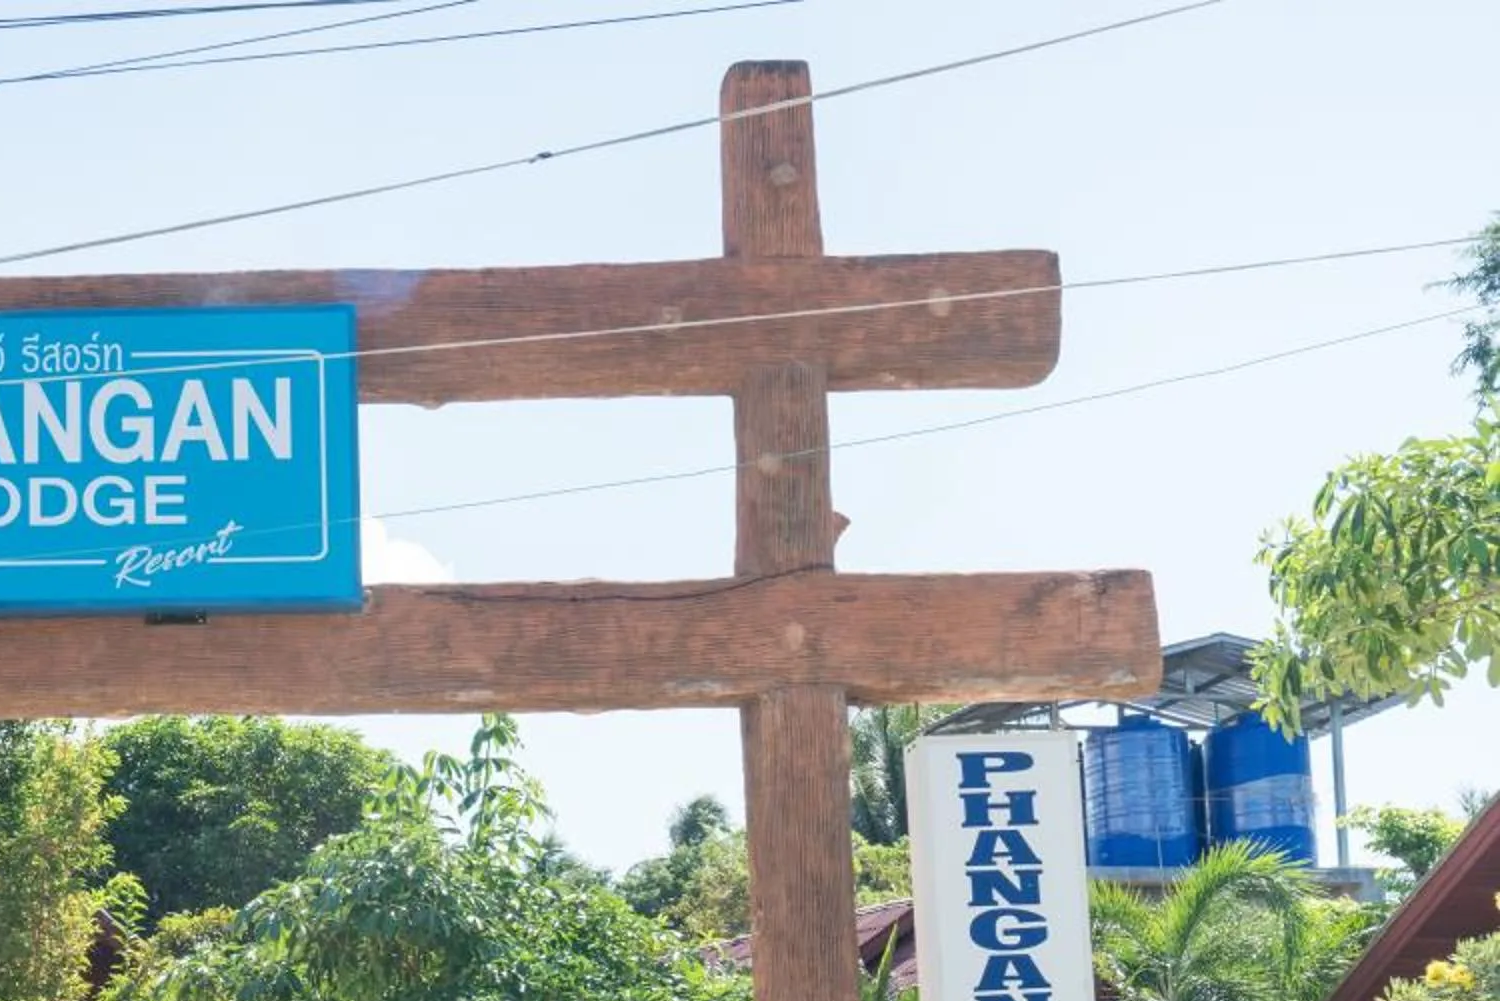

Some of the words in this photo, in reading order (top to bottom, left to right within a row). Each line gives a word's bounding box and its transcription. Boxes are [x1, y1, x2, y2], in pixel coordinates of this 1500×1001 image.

[21, 331, 123, 373] รีสอร์ท
[114, 519, 244, 589] Resort
